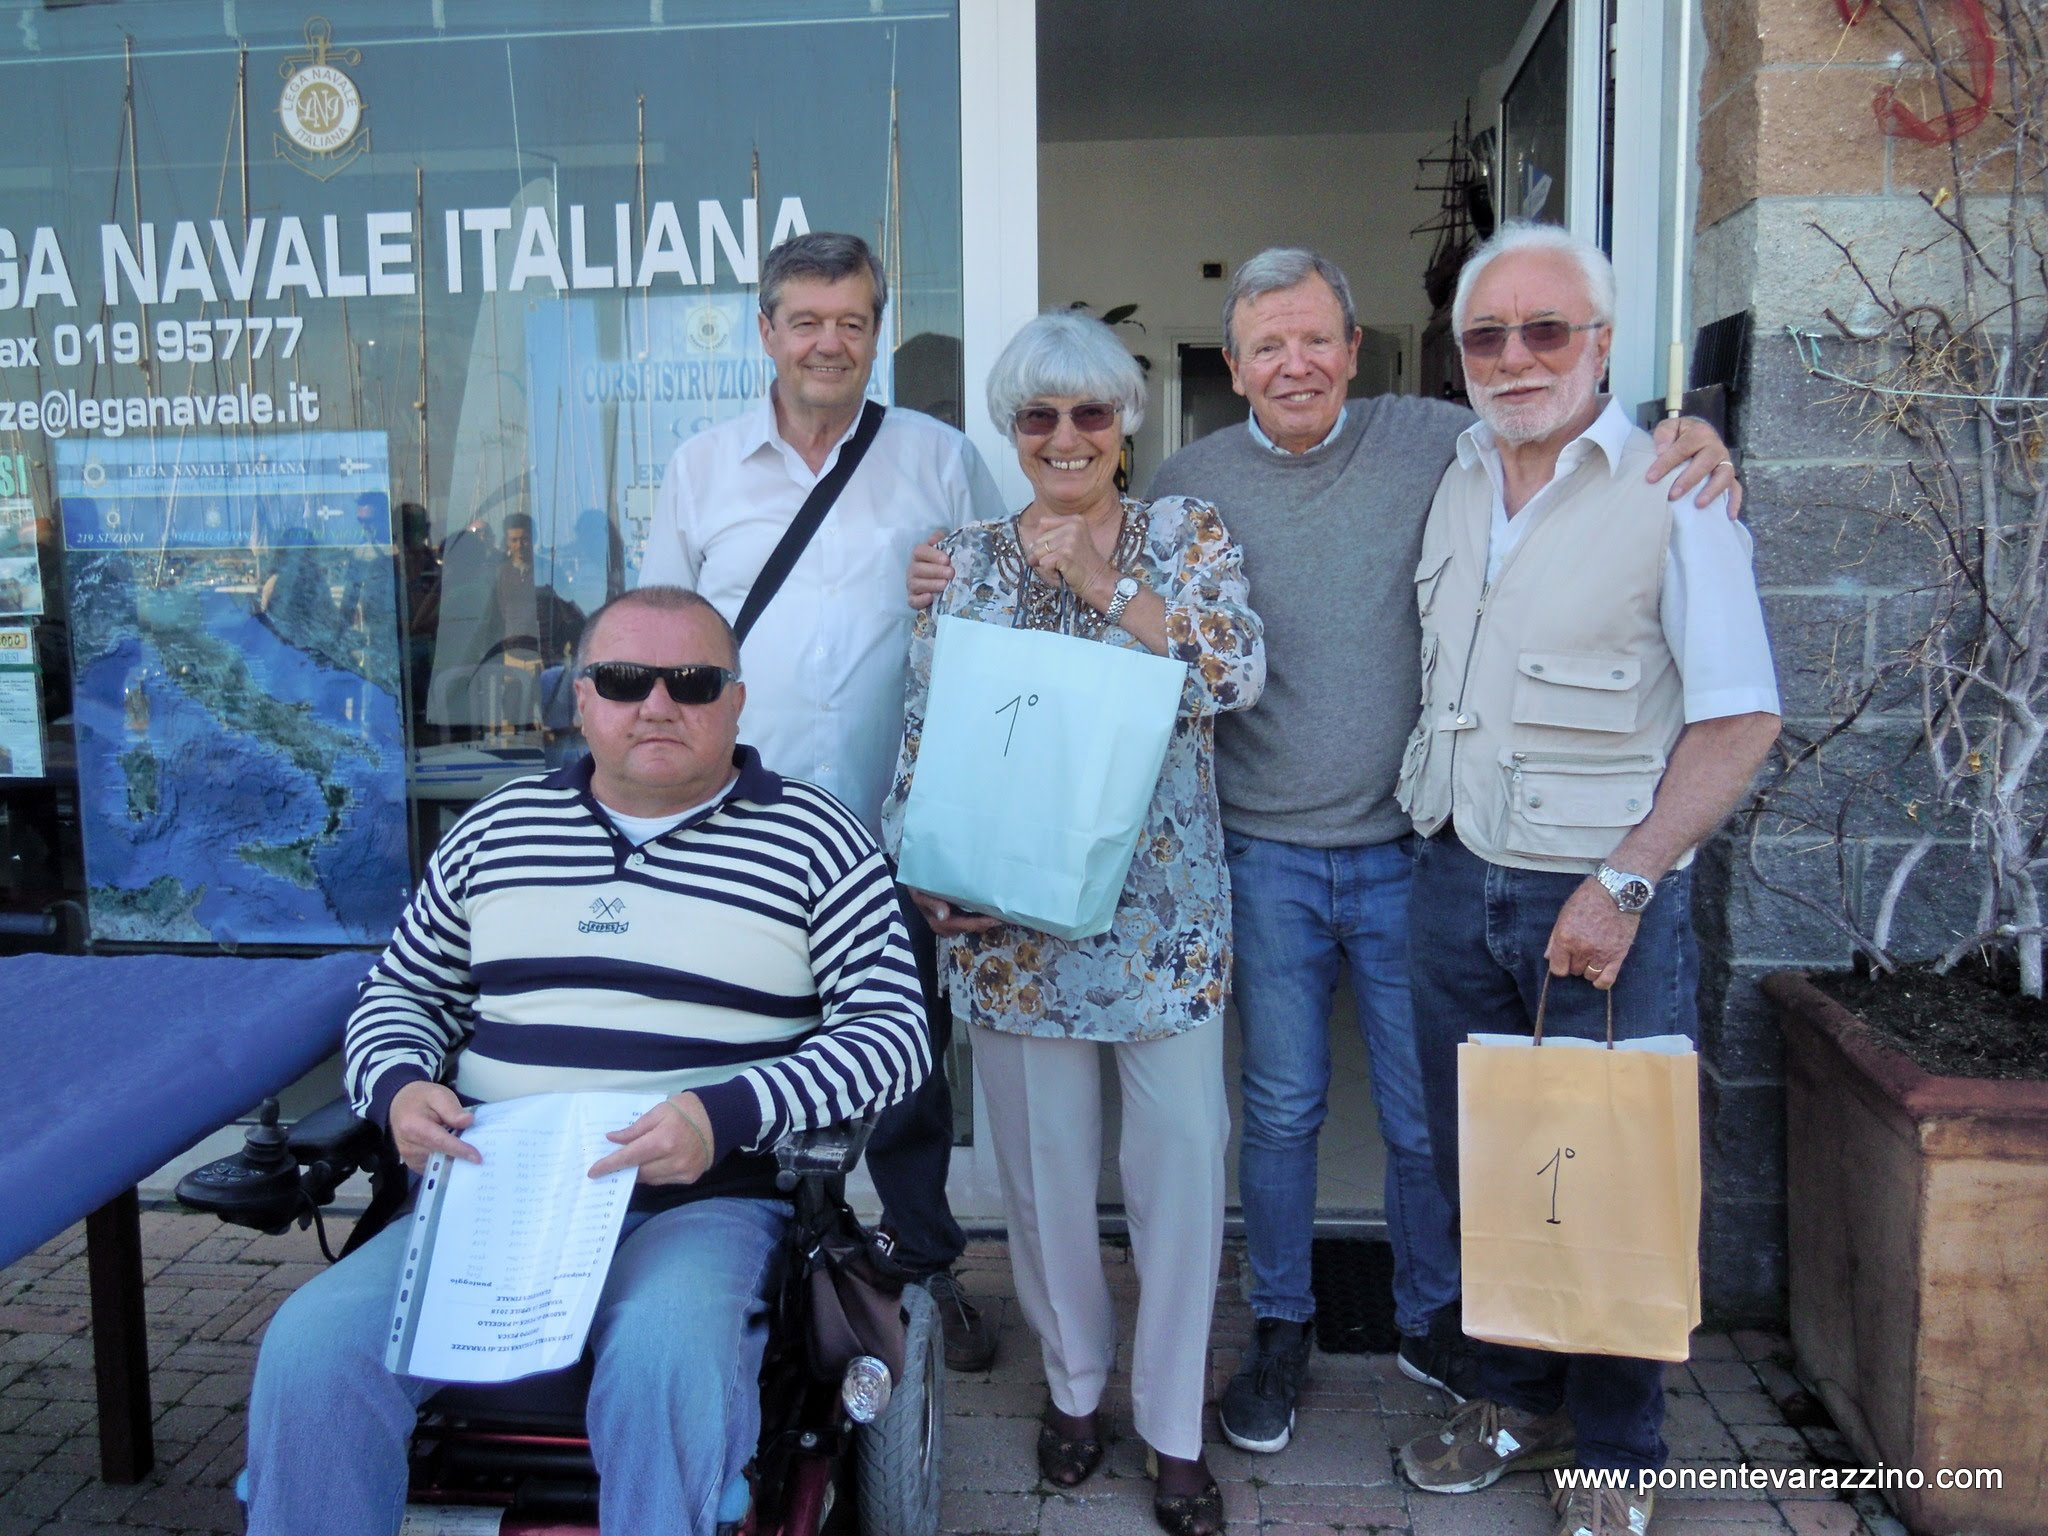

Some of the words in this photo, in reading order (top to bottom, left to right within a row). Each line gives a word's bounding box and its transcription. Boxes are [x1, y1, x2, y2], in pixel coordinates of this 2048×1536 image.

[284, 75, 309, 111] LEGA
[312, 69, 358, 108] NAVALE
[294, 127, 350, 147] ITALIANA
[101, 212, 416, 306] NAVALE
[54, 322, 140, 367] 019
[157, 317, 304, 363] 95777
[127, 465, 166, 479] LEGA
[173, 463, 230, 478] NAVALE
[236, 461, 306, 477] ITALIANA
[450, 1278, 493, 1287] punteggio
[450, 1343, 486, 1352] VARAZZE
